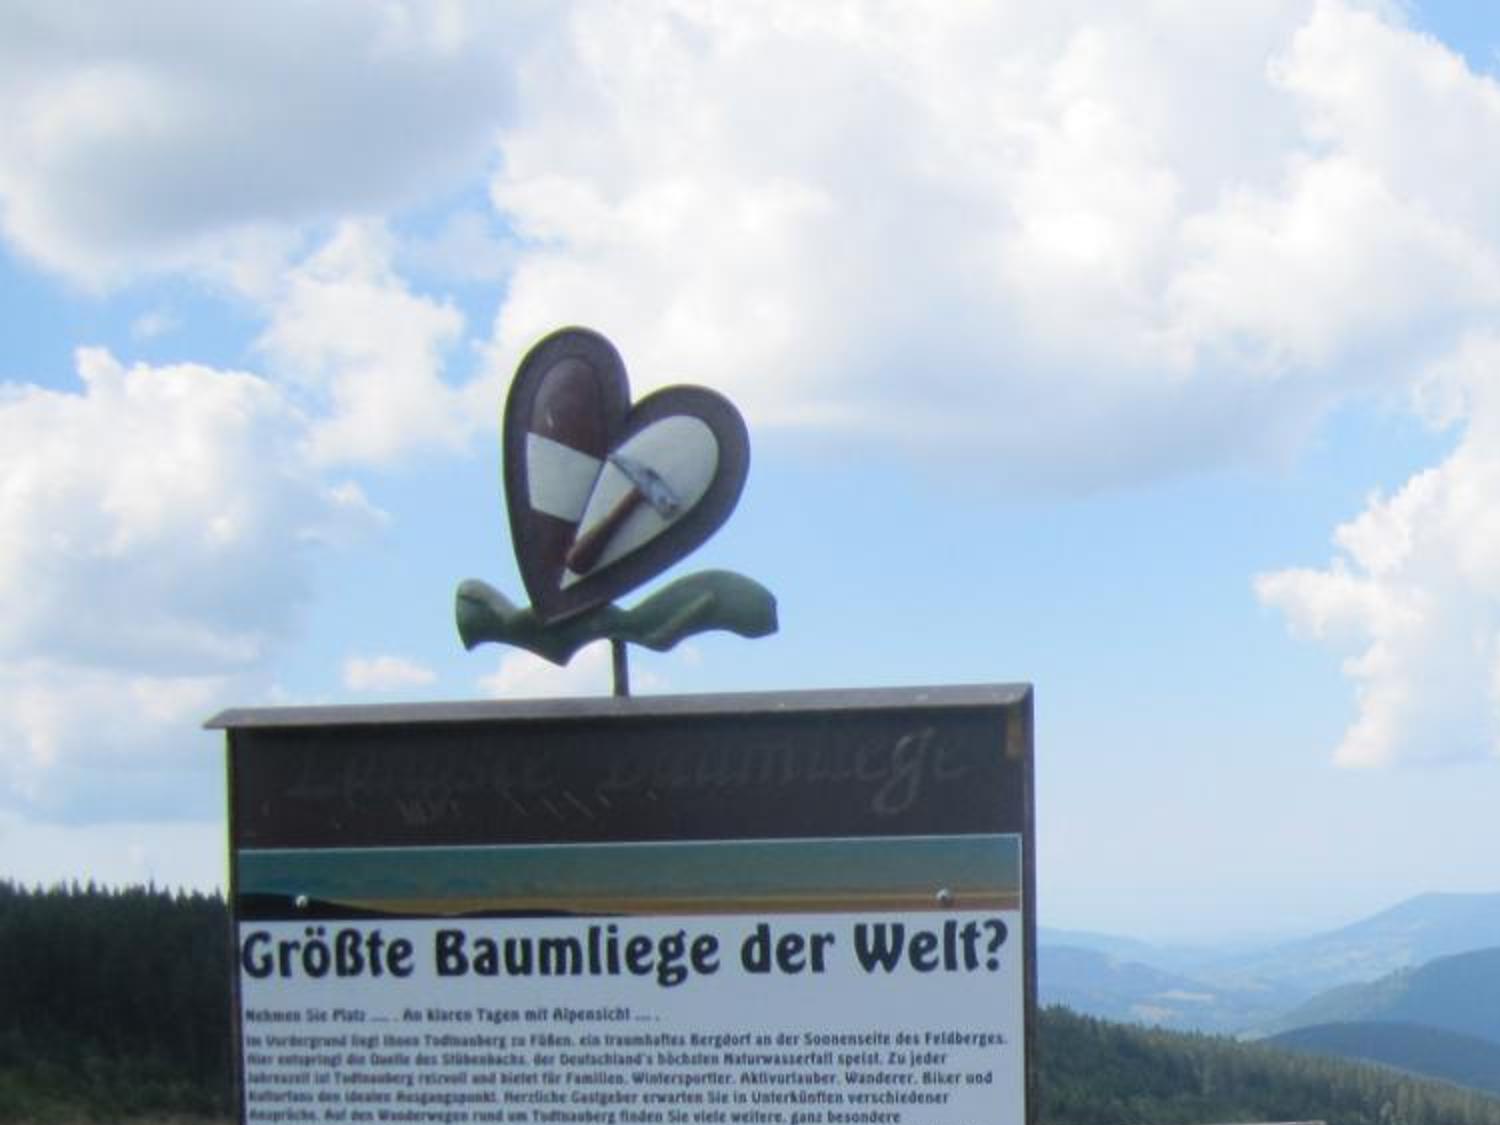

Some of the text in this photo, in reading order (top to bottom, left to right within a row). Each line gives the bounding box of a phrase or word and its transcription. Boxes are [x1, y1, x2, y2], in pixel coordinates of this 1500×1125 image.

[241, 918, 1009, 988] Größte Baumliege der Welt?
